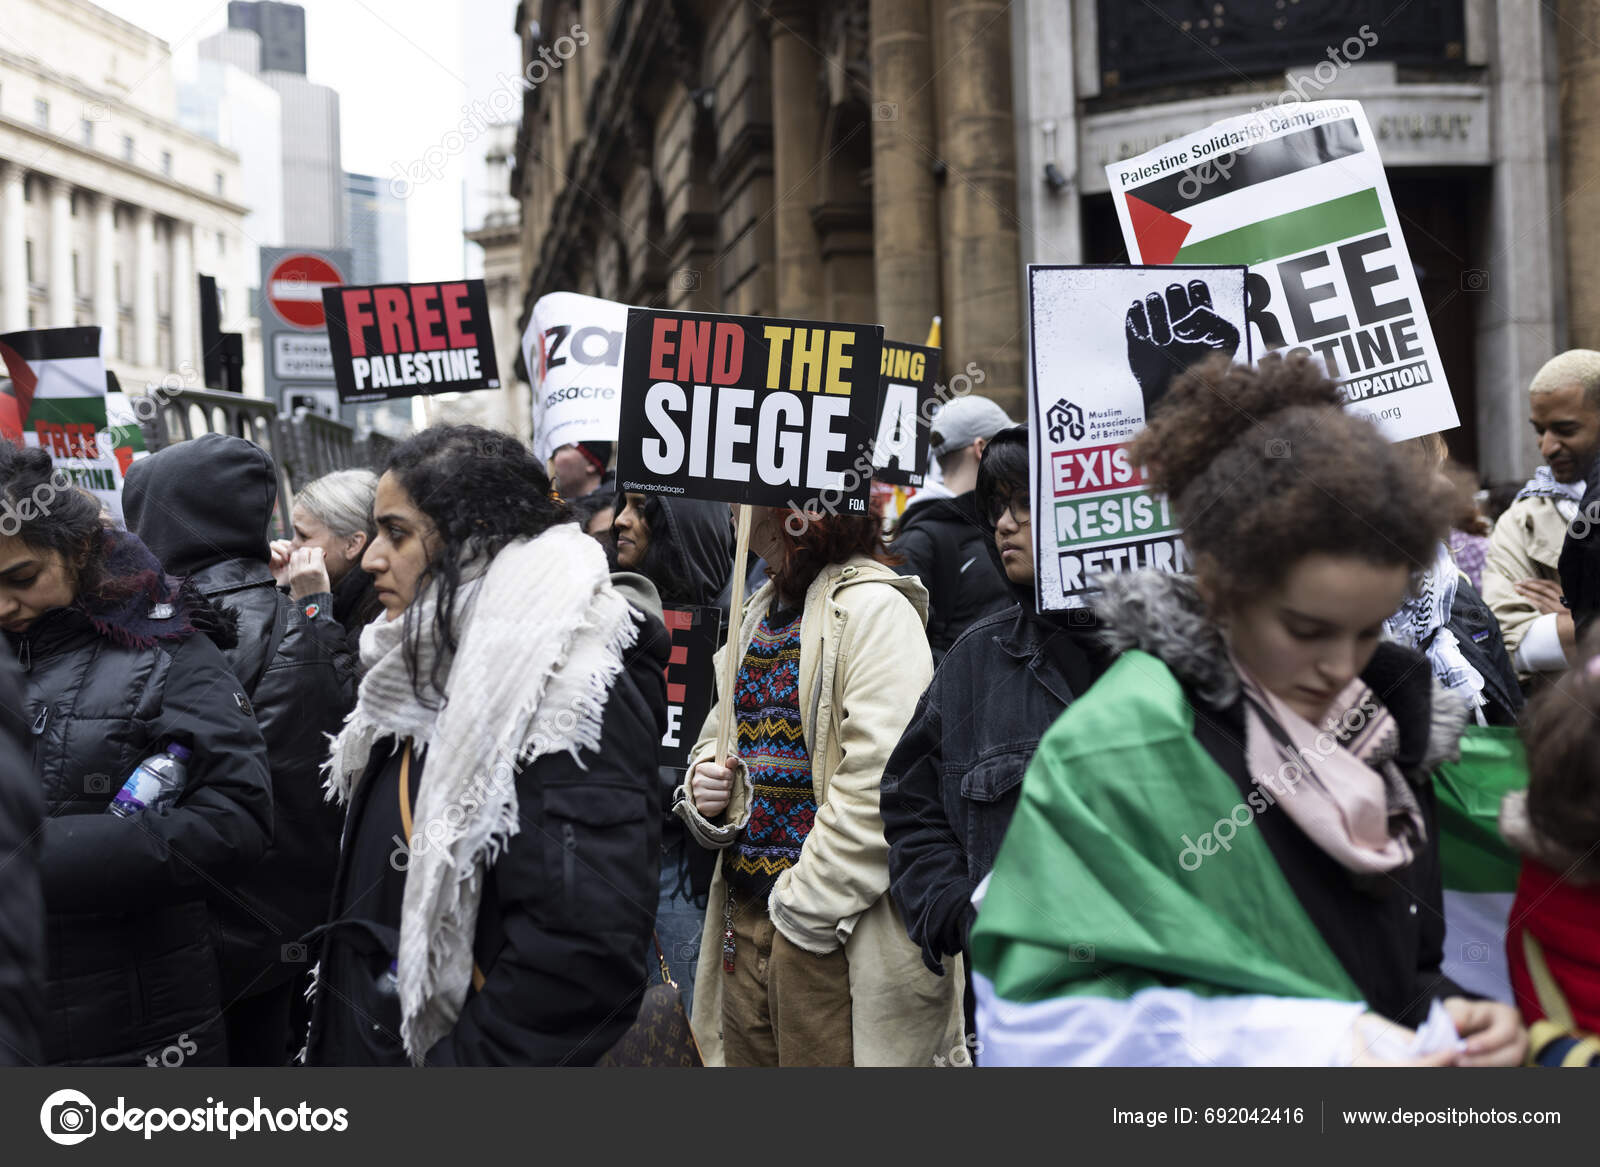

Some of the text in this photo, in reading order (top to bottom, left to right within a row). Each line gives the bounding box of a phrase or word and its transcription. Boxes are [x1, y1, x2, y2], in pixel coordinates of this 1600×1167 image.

[1120, 151, 1189, 186] Palestine
[1192, 123, 1265, 159] Solidarity
[1269, 105, 1350, 134] Campaign
[341, 283, 478, 357] FREE
[352, 348, 483, 390] PALESTINE
[649, 317, 856, 395] END THE
[871, 383, 918, 473] A
[1089, 408, 1122, 420] Muslim
[1090, 416, 1142, 430] Association
[1091, 427, 1134, 440] of Britain
[34, 420, 99, 460] FREE
[641, 382, 851, 491] SIEGE
[848, 498, 866, 511] FOA
